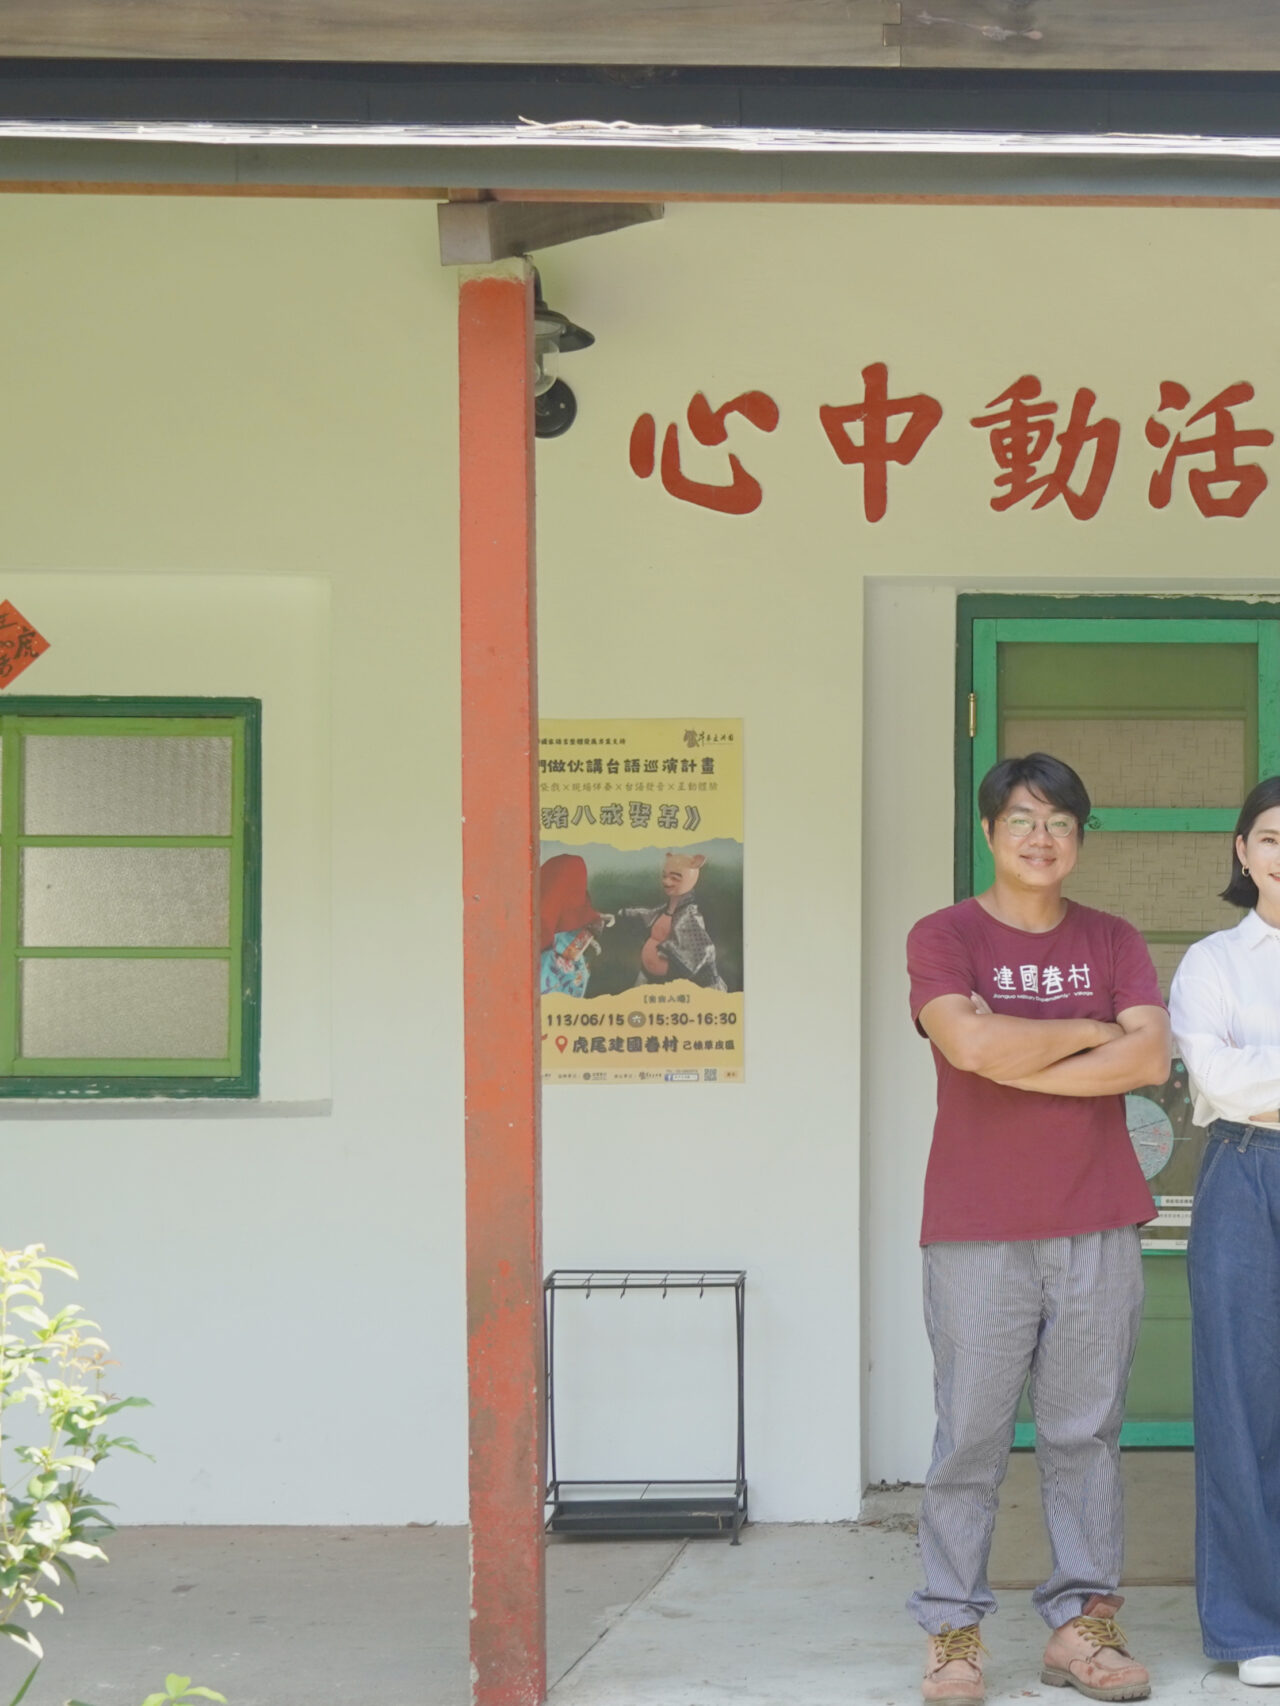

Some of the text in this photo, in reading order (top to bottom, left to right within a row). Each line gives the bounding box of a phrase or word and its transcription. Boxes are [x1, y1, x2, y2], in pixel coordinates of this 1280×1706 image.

[993, 963, 1090, 995] 建國眷村
[547, 1013, 625, 1026] 113/06/15
[648, 1012, 738, 1026] 15:30-16:30
